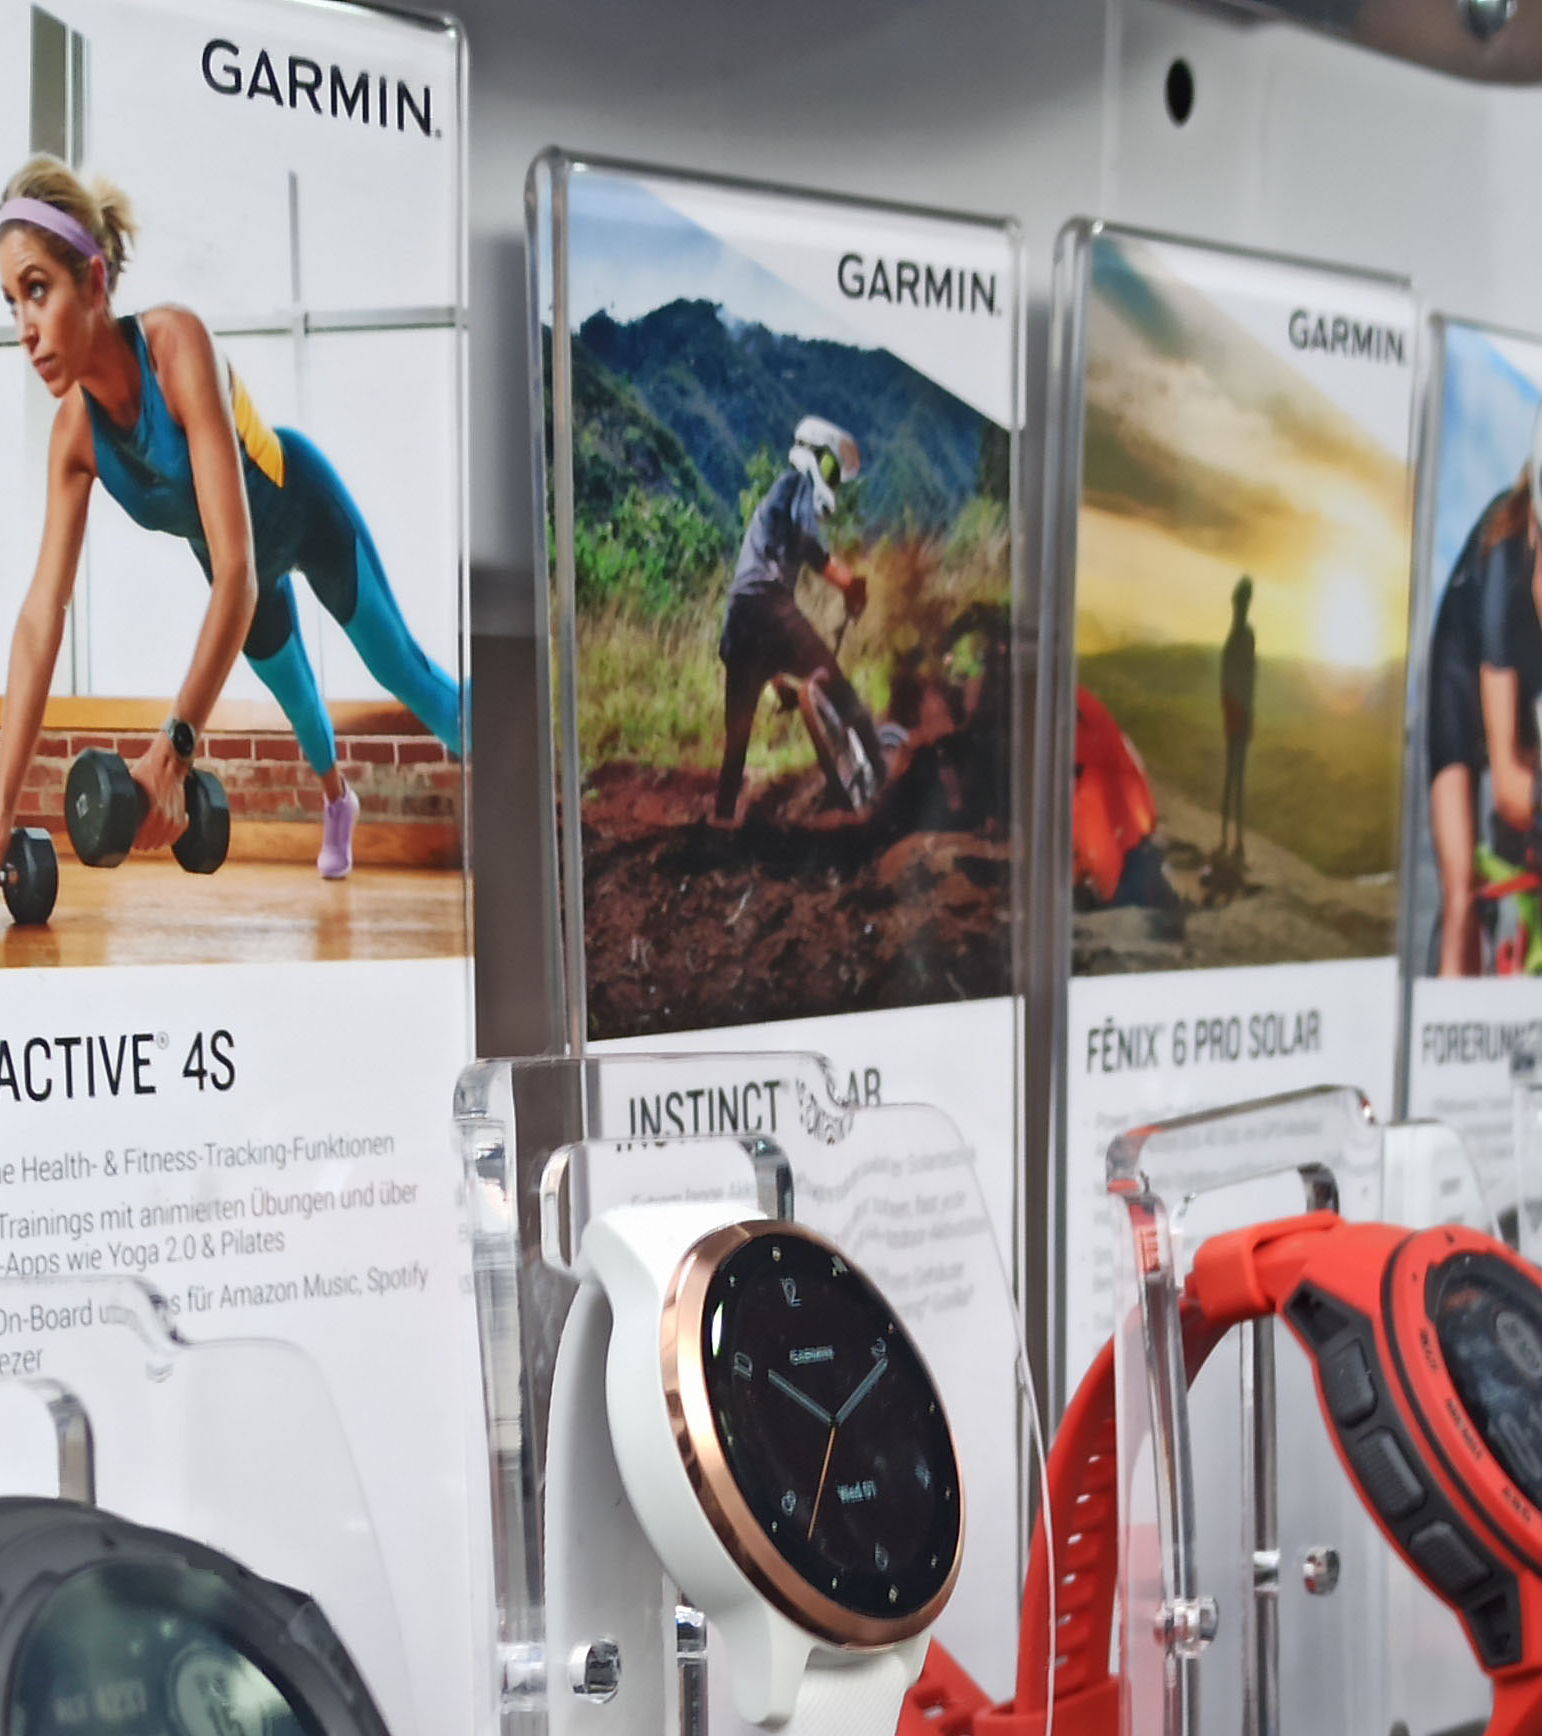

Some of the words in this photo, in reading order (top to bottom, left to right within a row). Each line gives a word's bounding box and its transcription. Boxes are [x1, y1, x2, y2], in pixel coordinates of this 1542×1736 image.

[182, 1030, 237, 1092] 4S
[1172, 1020, 1187, 1066] 6
[1195, 1019, 1241, 1062] PRO
[1249, 1010, 1322, 1059] SOLAR
[21, 1152, 97, 1183] Health-
[104, 1150, 117, 1177] &
[124, 1133, 395, 1175] Fitness-Tracking-Funktionen
[100, 1201, 134, 1230] mit
[140, 1197, 245, 1228] animierten
[251, 1186, 335, 1220] Übungen
[340, 1181, 374, 1206] und
[379, 1180, 418, 1204] über
[66, 1243, 102, 1272] wie
[107, 1241, 160, 1273] Yoga
[165, 1235, 196, 1263] 2.0
[202, 1232, 215, 1258] &
[222, 1229, 286, 1256] Pilates
[187, 1284, 213, 1313] für
[219, 1280, 298, 1308] Amazon
[367, 1260, 430, 1295] Spotify
